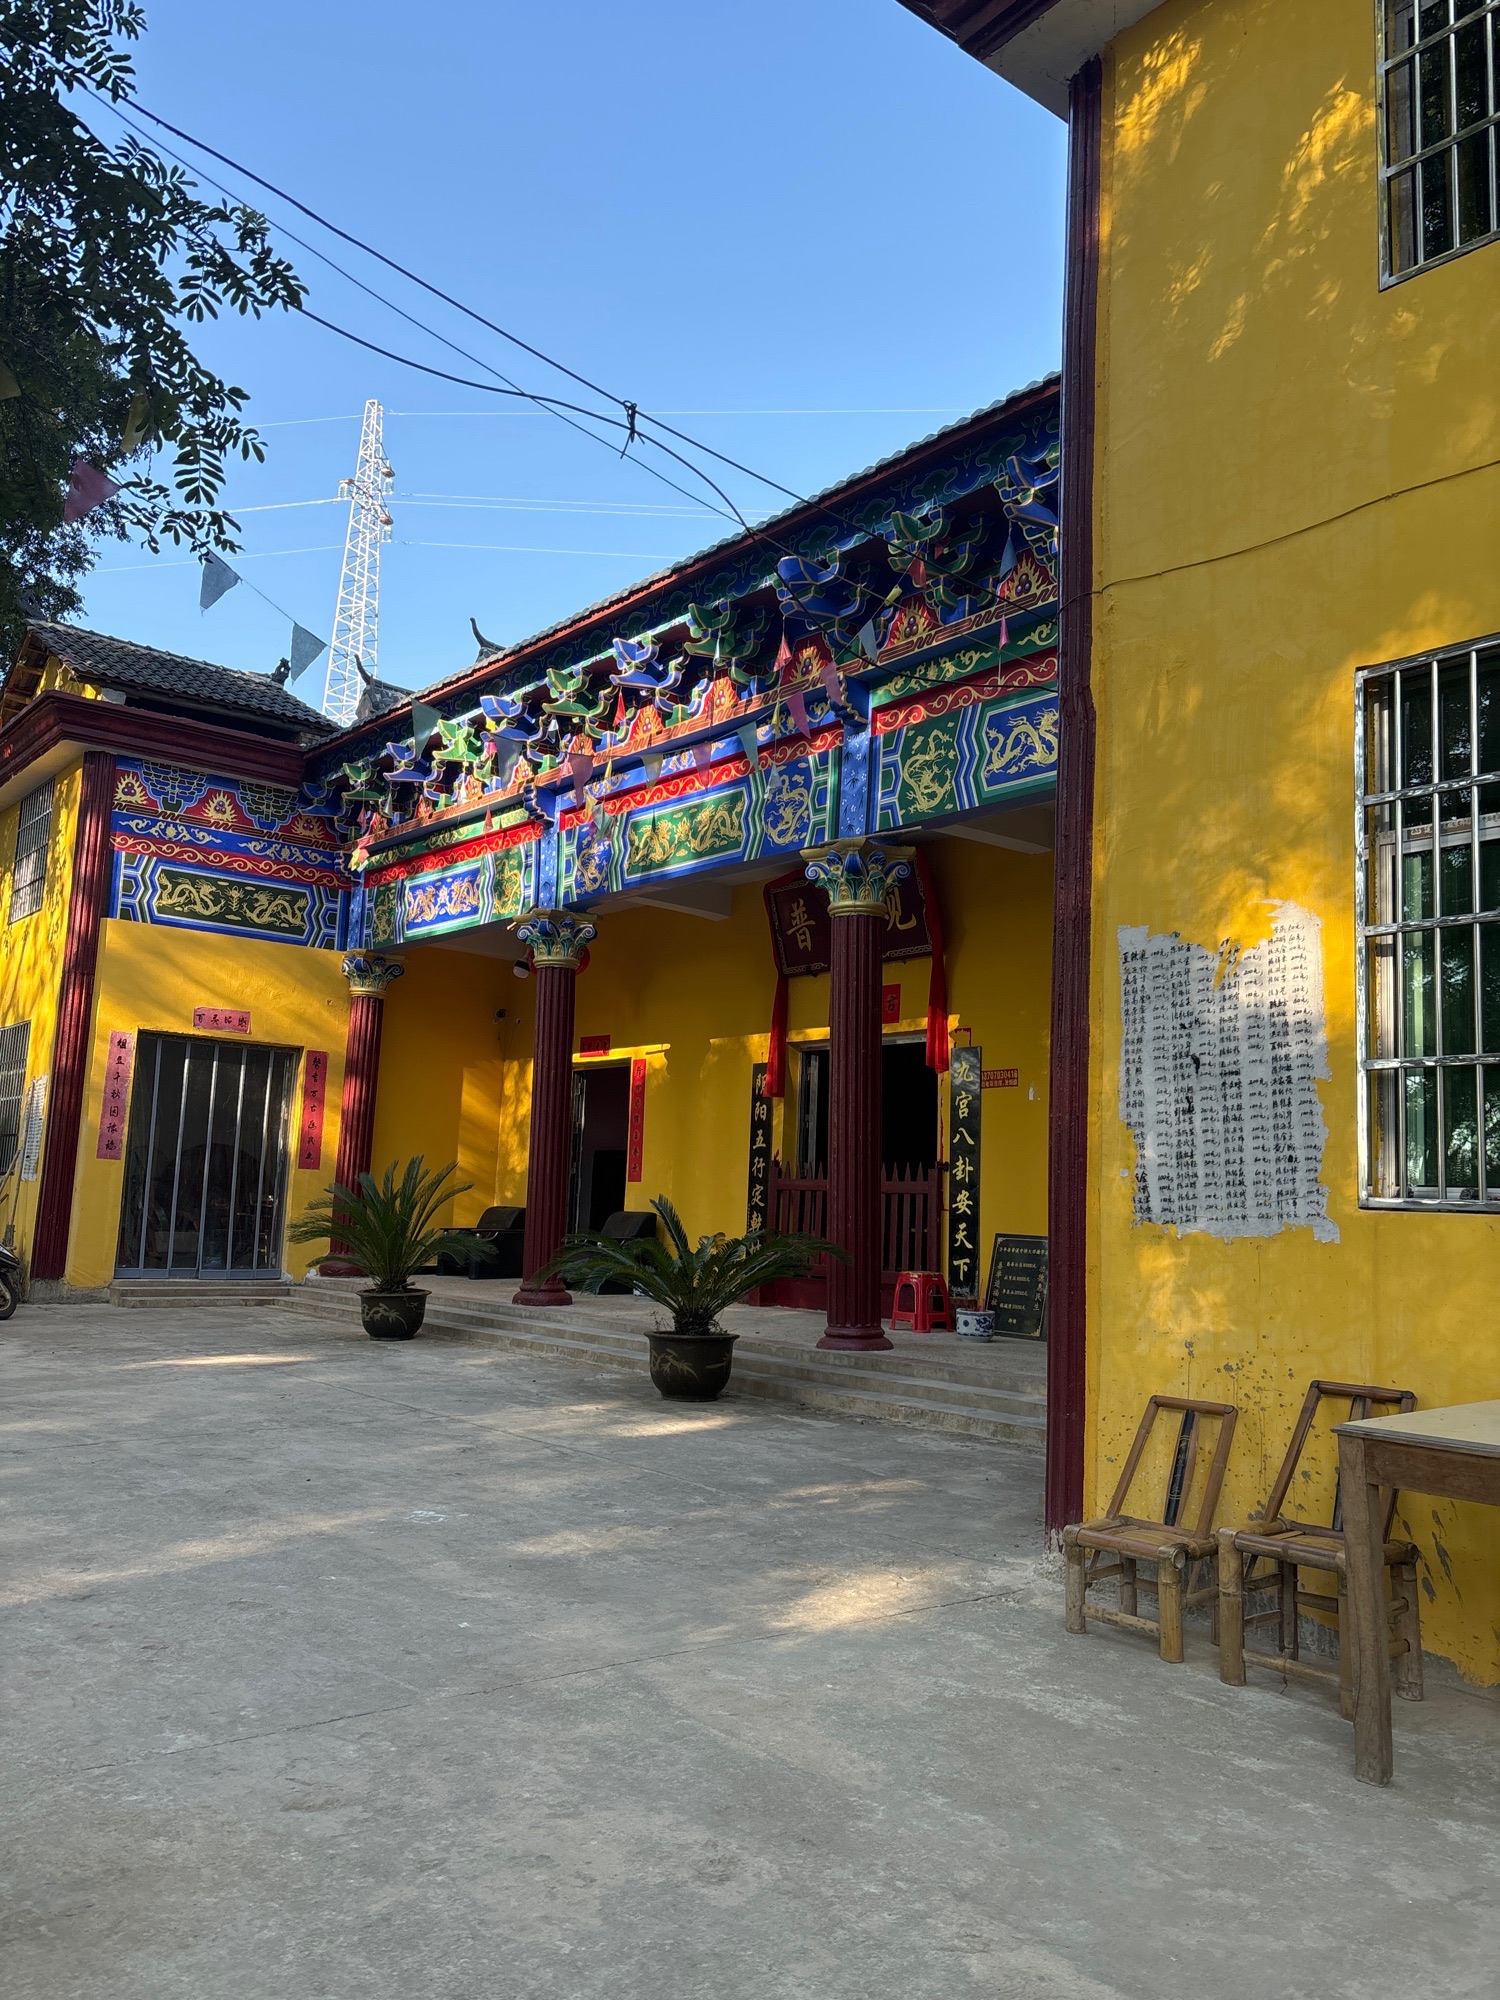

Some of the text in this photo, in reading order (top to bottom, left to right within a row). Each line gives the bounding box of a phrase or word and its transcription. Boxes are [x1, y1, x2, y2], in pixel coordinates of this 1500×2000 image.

[952, 1060, 976, 1282] 九宫八卦安天下
